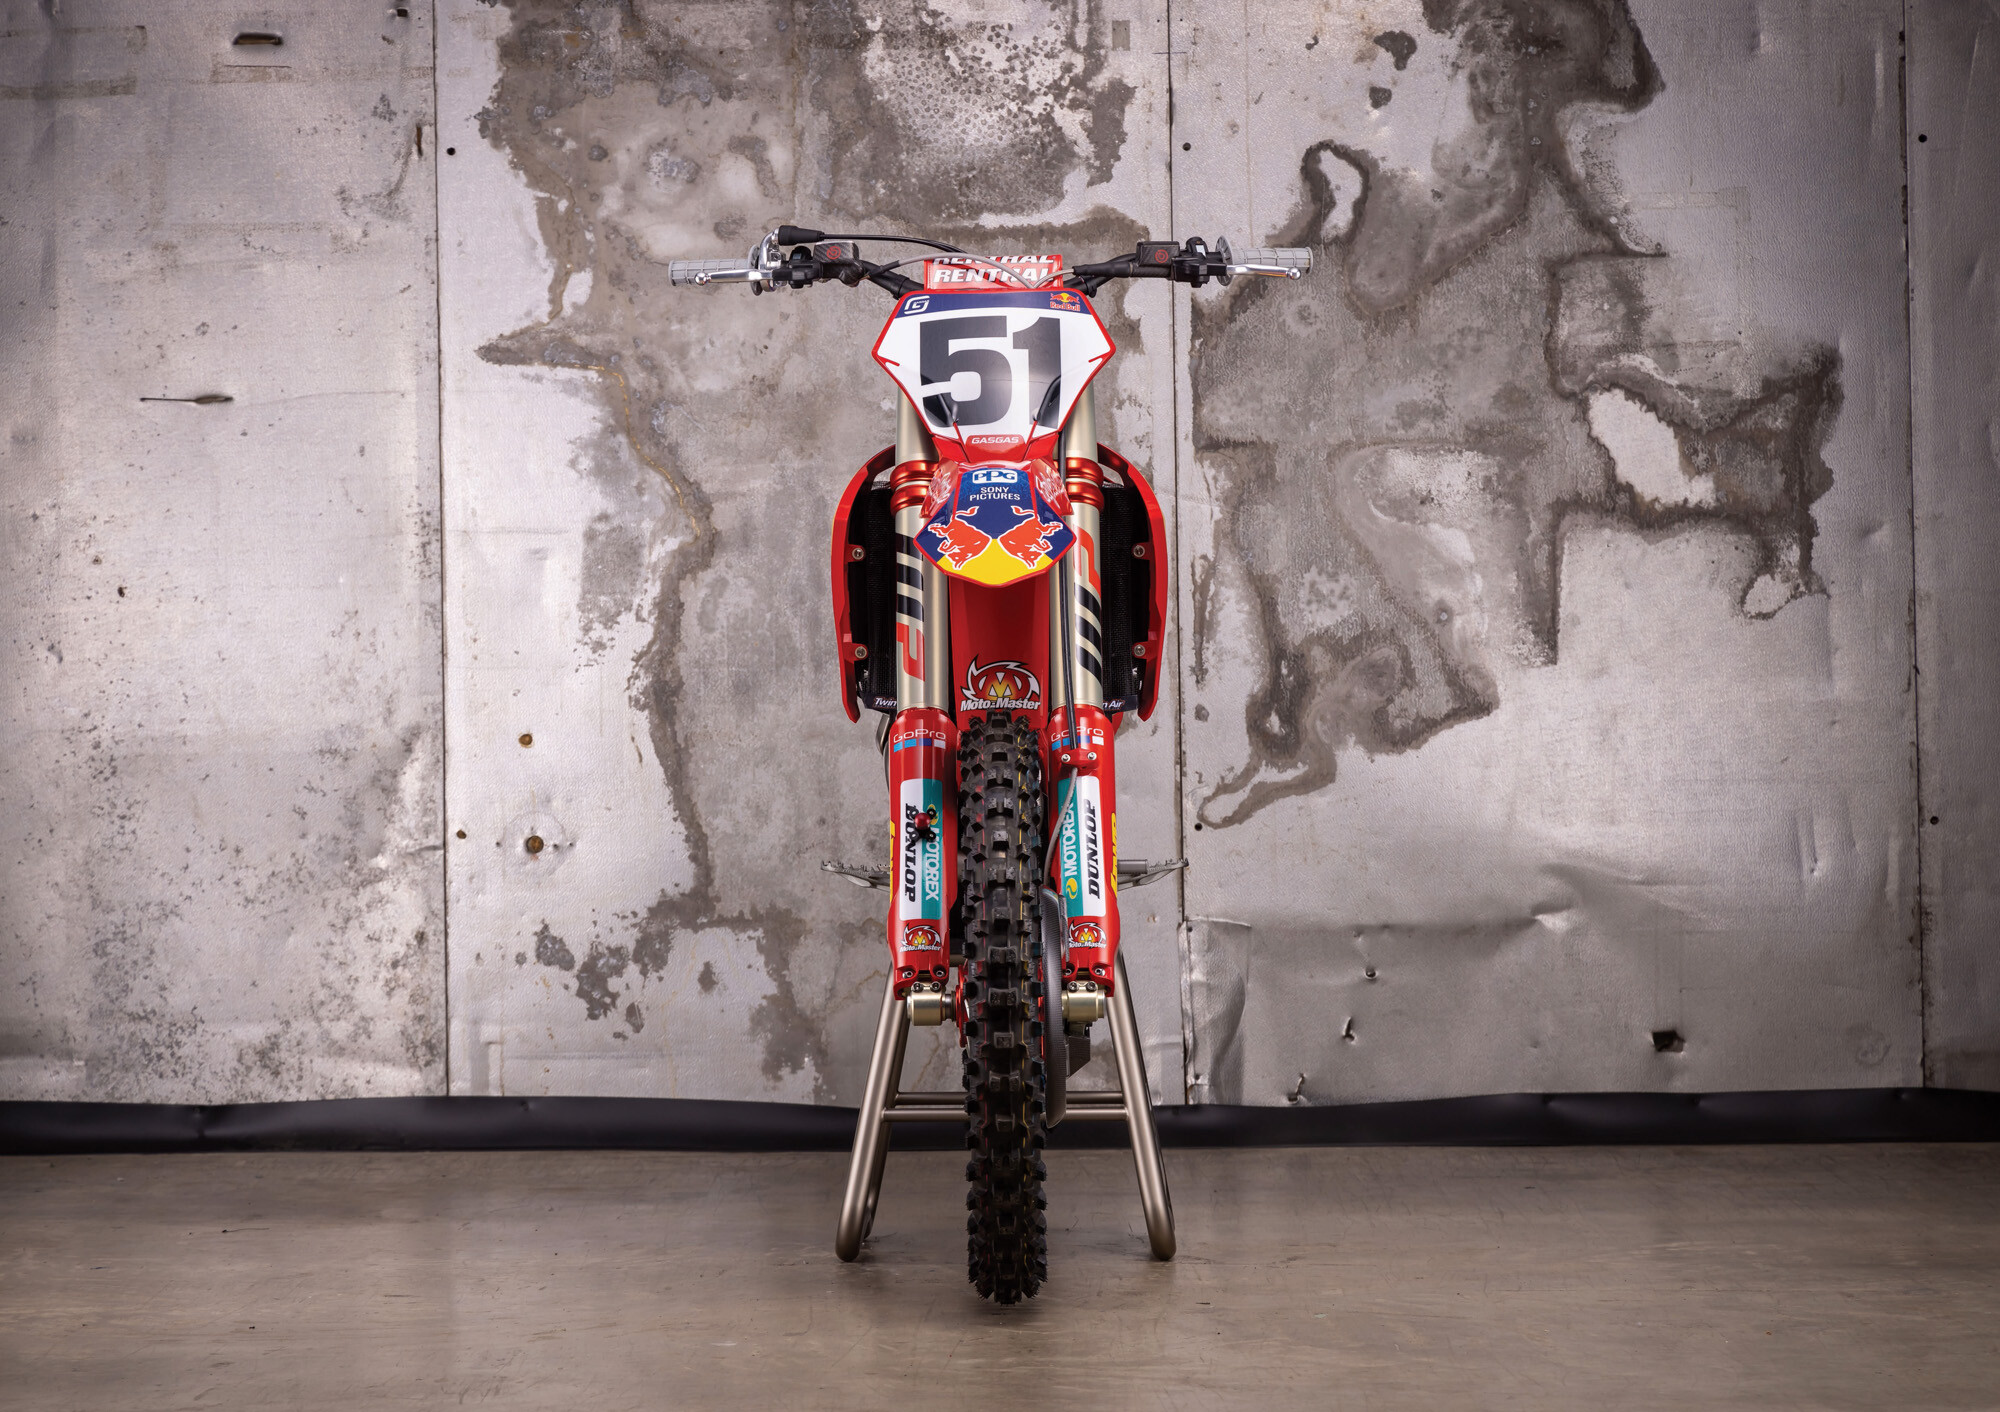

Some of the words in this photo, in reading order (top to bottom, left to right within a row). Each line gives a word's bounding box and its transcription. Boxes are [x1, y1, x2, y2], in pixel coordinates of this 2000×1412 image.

[933, 268, 1054, 283] RENTHAL
[1050, 301, 1066, 310] Red
[1066, 303, 1081, 312] Bull
[920, 315, 1062, 430] 51
[971, 436, 1019, 444] GASGAS
[974, 470, 1016, 481] PPG
[981, 486, 1010, 494] SONY
[969, 492, 1021, 501] PICTURES
[875, 697, 897, 707] Twin
[1108, 700, 1124, 708] Air
[893, 728, 946, 743] GoPro
[1084, 799, 1100, 899] DUNLOP
